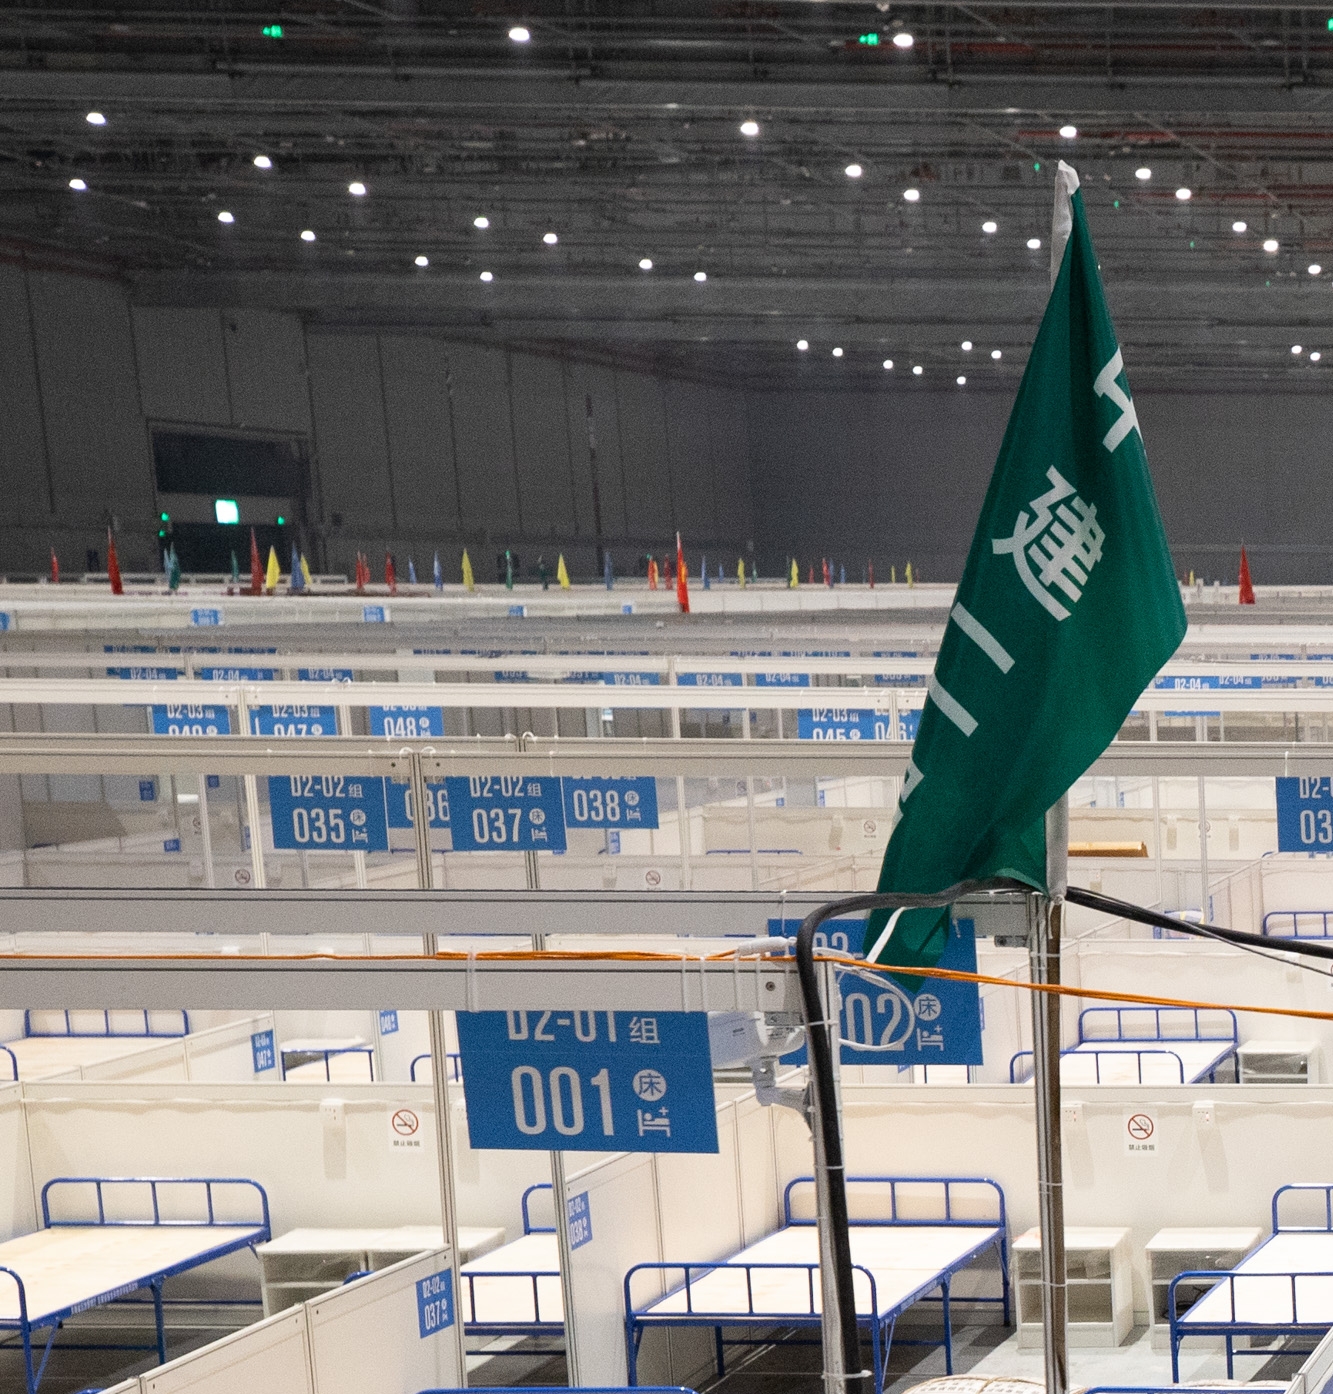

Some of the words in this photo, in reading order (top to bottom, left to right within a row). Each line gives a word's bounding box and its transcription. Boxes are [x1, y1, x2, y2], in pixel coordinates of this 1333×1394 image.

[289, 776, 346, 798] D2-02
[469, 776, 525, 798] D2-02
[572, 789, 621, 822] 038
[292, 808, 346, 843] 035
[472, 808, 522, 844] 037
[506, 1010, 617, 1043] D2-01
[629, 1017, 661, 1044] 组
[844, 993, 904, 1051] 02
[510, 1065, 615, 1136] 001
[424, 1300, 441, 1331] 037
